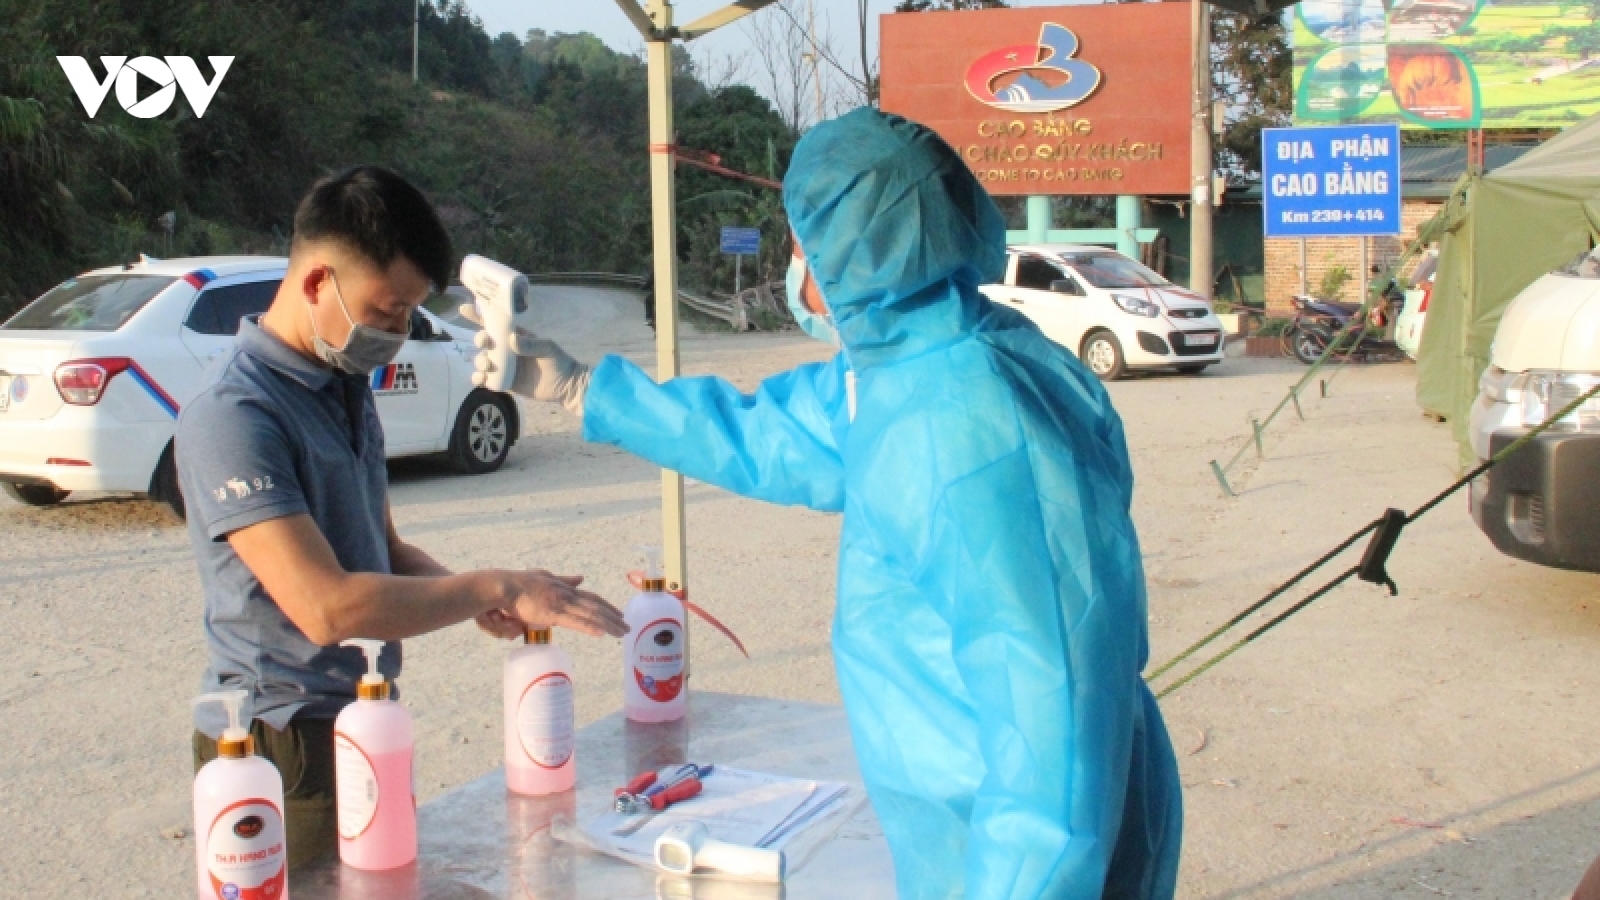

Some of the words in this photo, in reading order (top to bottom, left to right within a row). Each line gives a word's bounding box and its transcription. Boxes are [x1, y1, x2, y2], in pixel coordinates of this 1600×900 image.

[978, 119, 1027, 138] CAO
[1088, 138, 1163, 162] KHÁCH
[1277, 141, 1314, 164] ĐỊA
[1330, 133, 1389, 162] PHẬN
[1025, 168, 1041, 182] TO
[1043, 168, 1078, 182] CAO
[1272, 172, 1318, 197] CAO
[1324, 161, 1389, 196] BẰNG
[1282, 210, 1309, 223] Km
